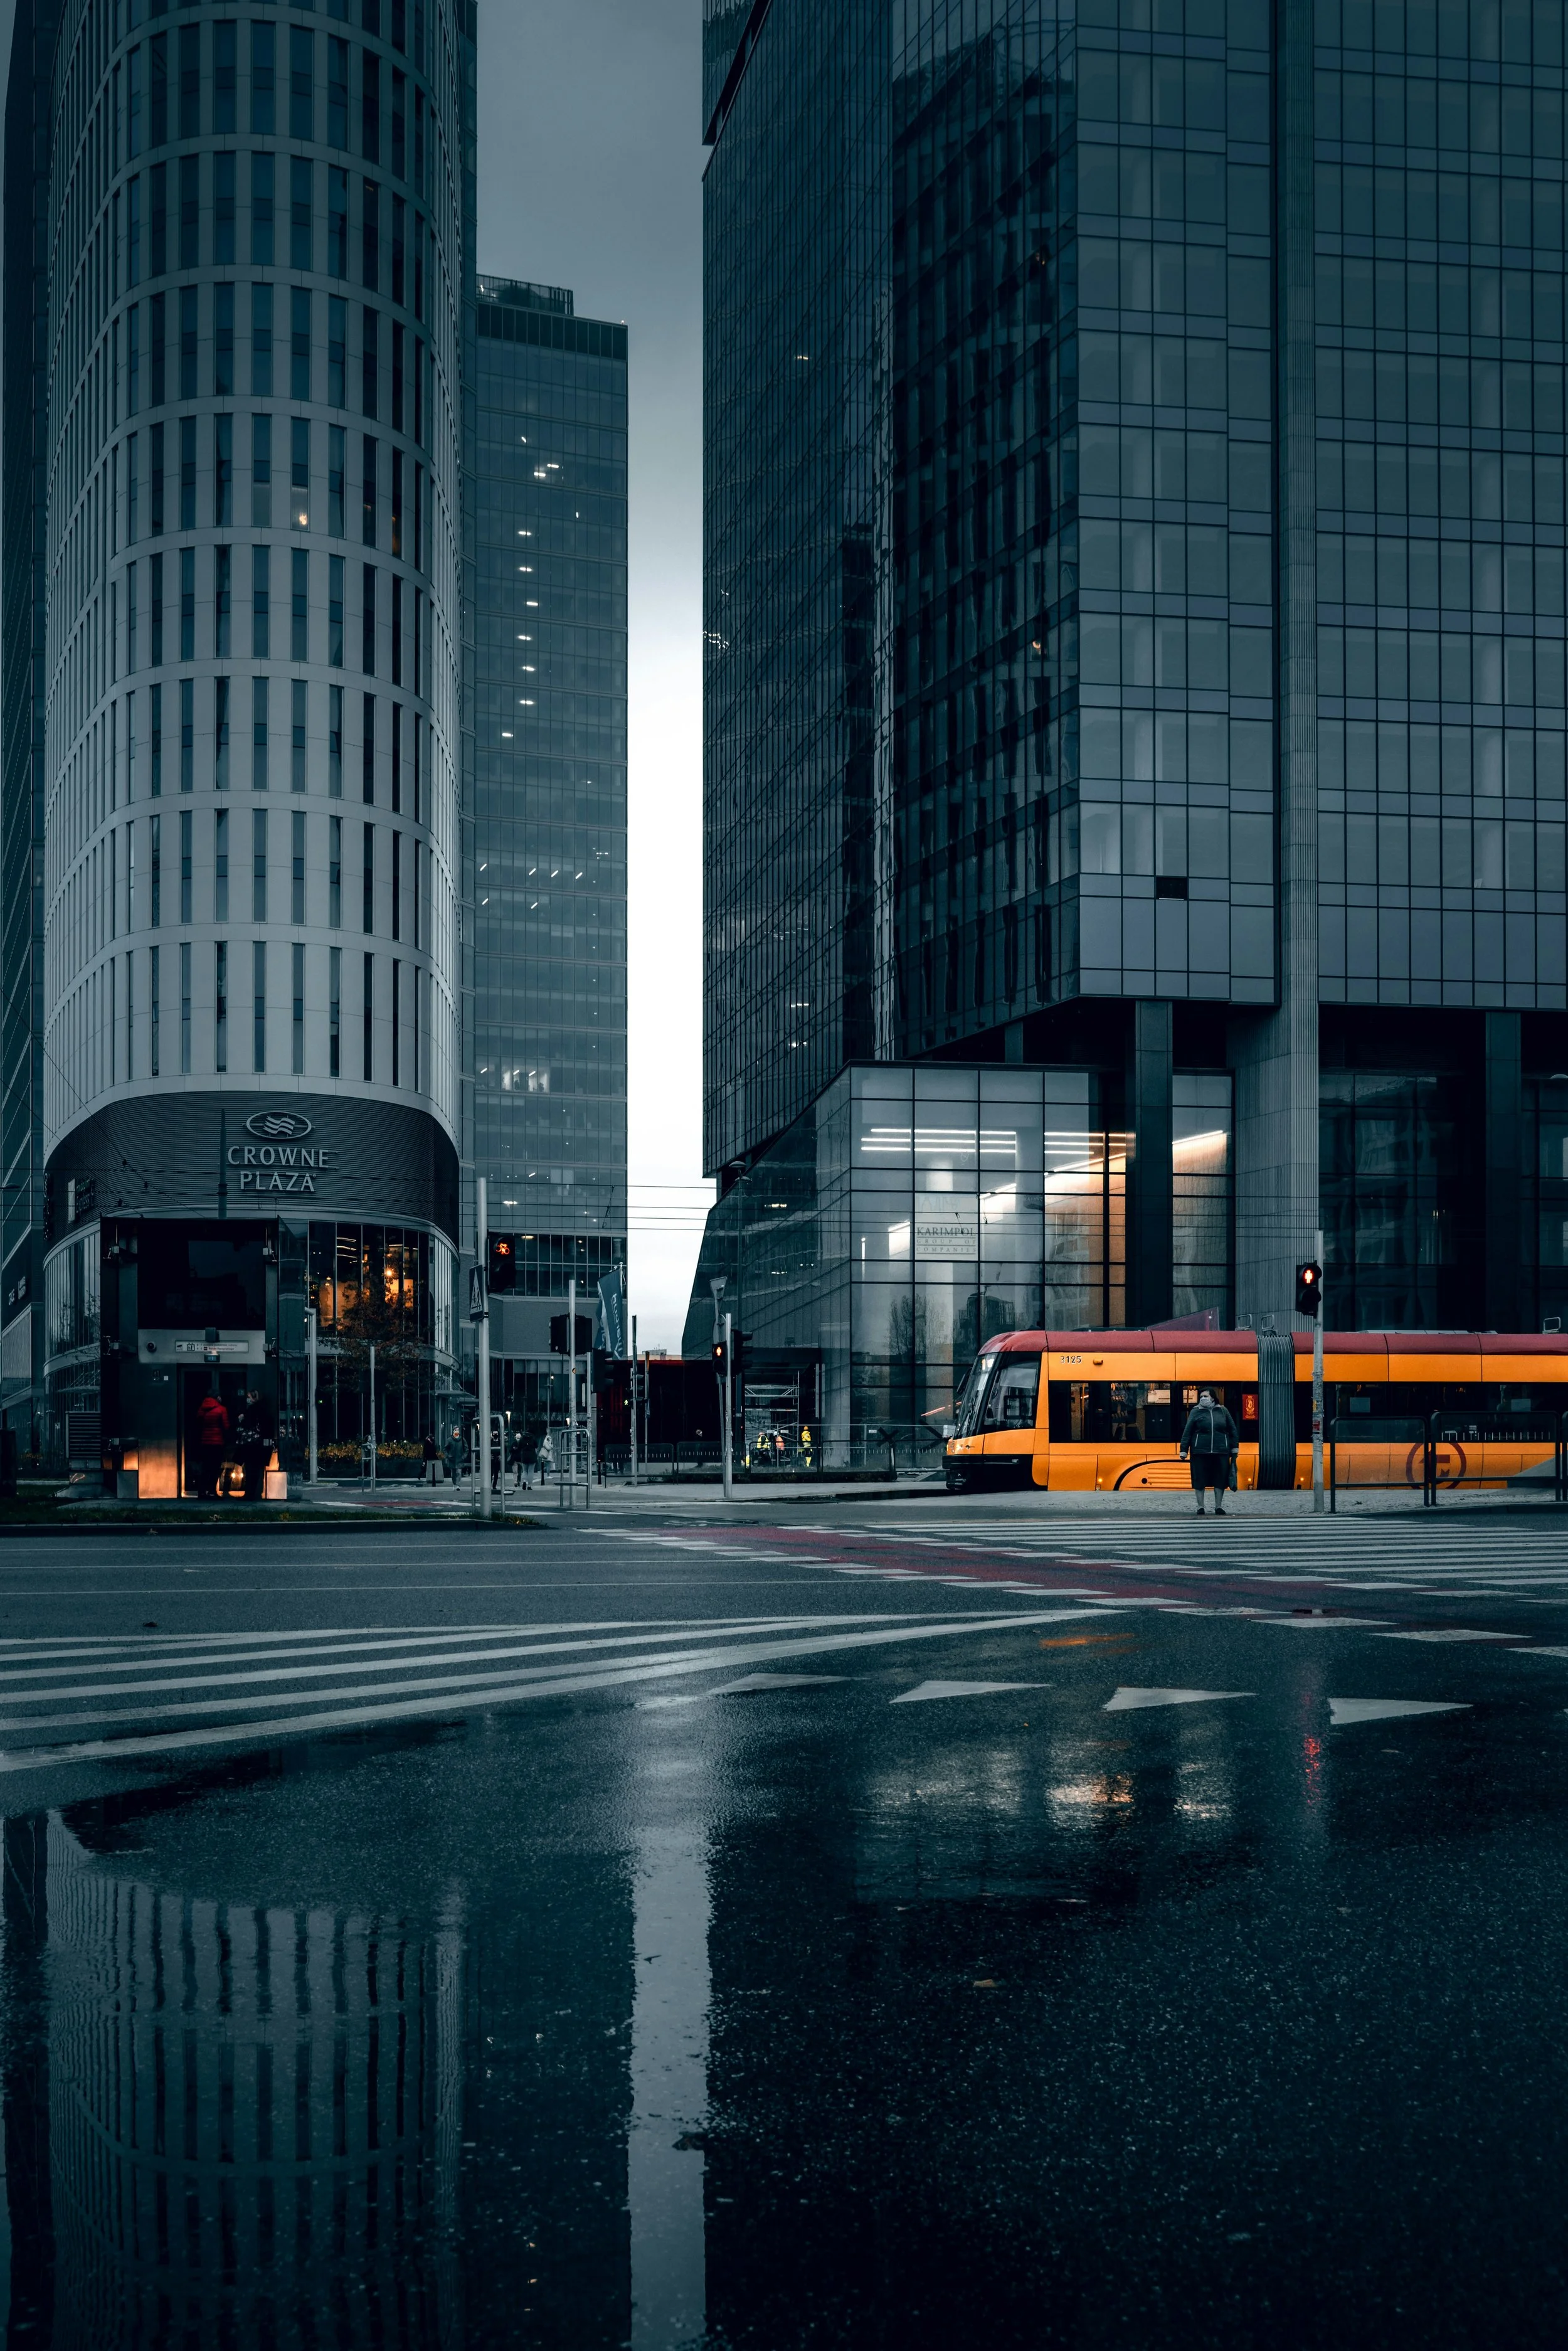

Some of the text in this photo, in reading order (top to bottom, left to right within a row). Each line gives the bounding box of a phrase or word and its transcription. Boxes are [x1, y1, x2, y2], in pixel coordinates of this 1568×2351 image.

[228, 1145, 329, 1167] CROWNE
[240, 1170, 315, 1192] PLAZA
[916, 1227, 976, 1237] KARIMPOL
